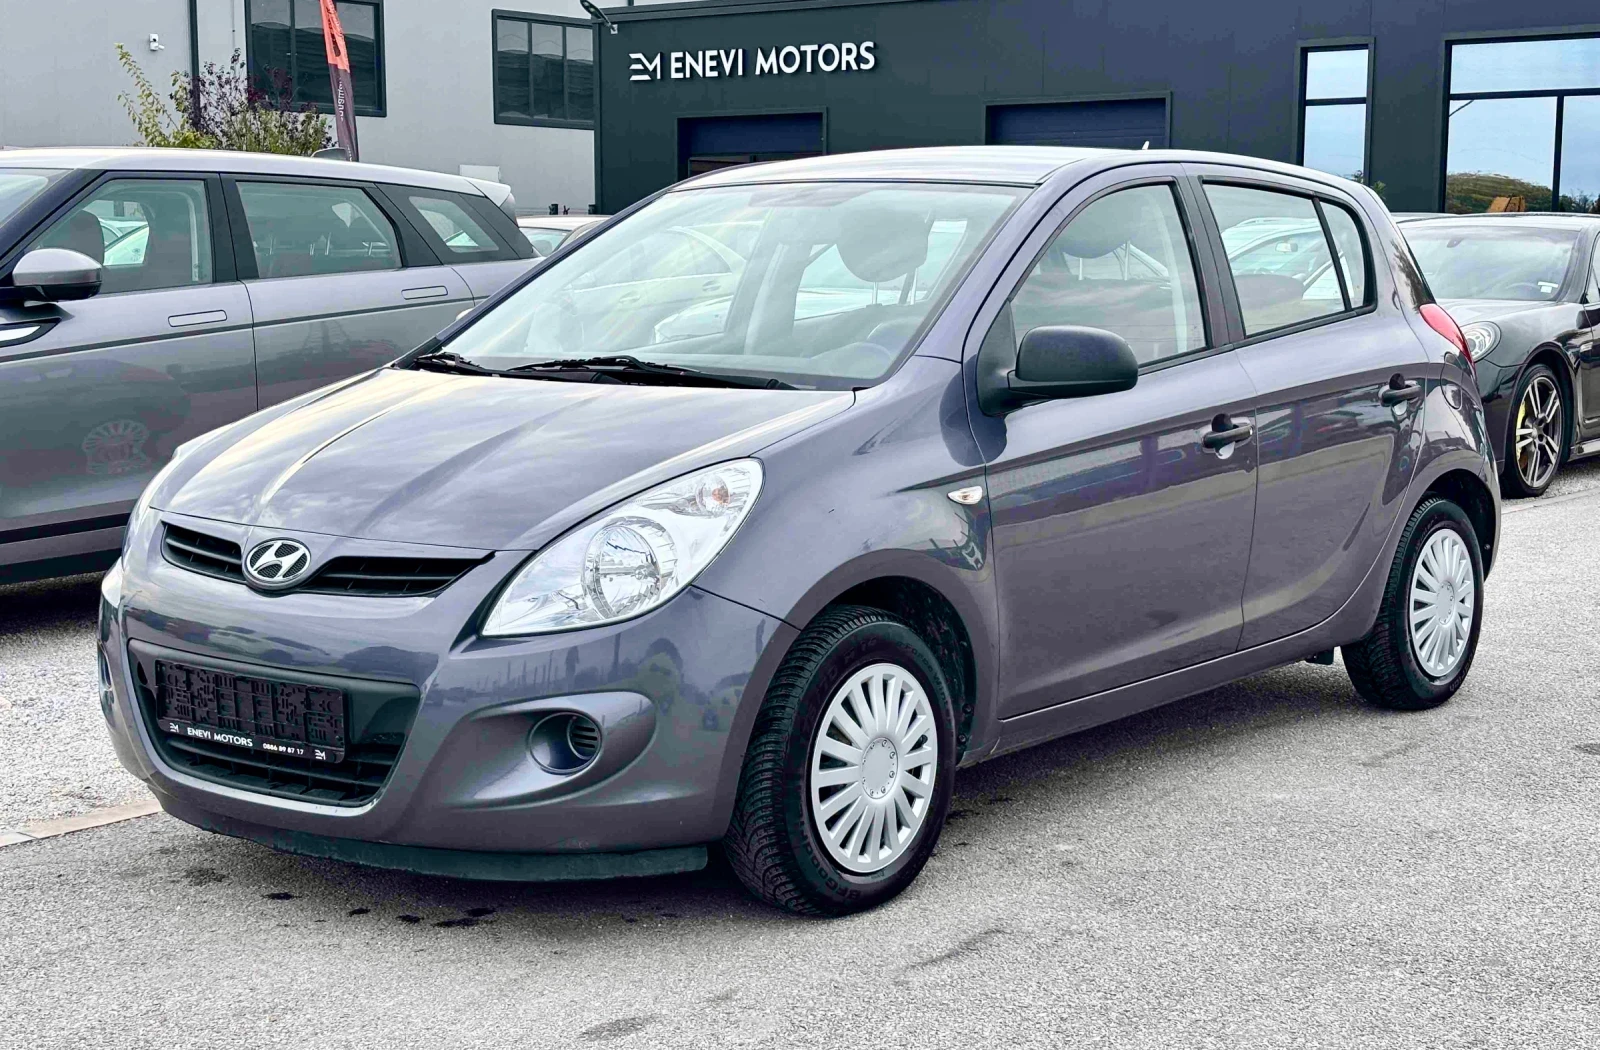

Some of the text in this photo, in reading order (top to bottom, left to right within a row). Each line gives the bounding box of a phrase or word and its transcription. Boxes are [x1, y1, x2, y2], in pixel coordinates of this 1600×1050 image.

[670, 48, 743, 79] ENEVI
[754, 41, 876, 76] MOTORS
[187, 727, 212, 740] ENEVI
[213, 732, 254, 747] MOTORS
